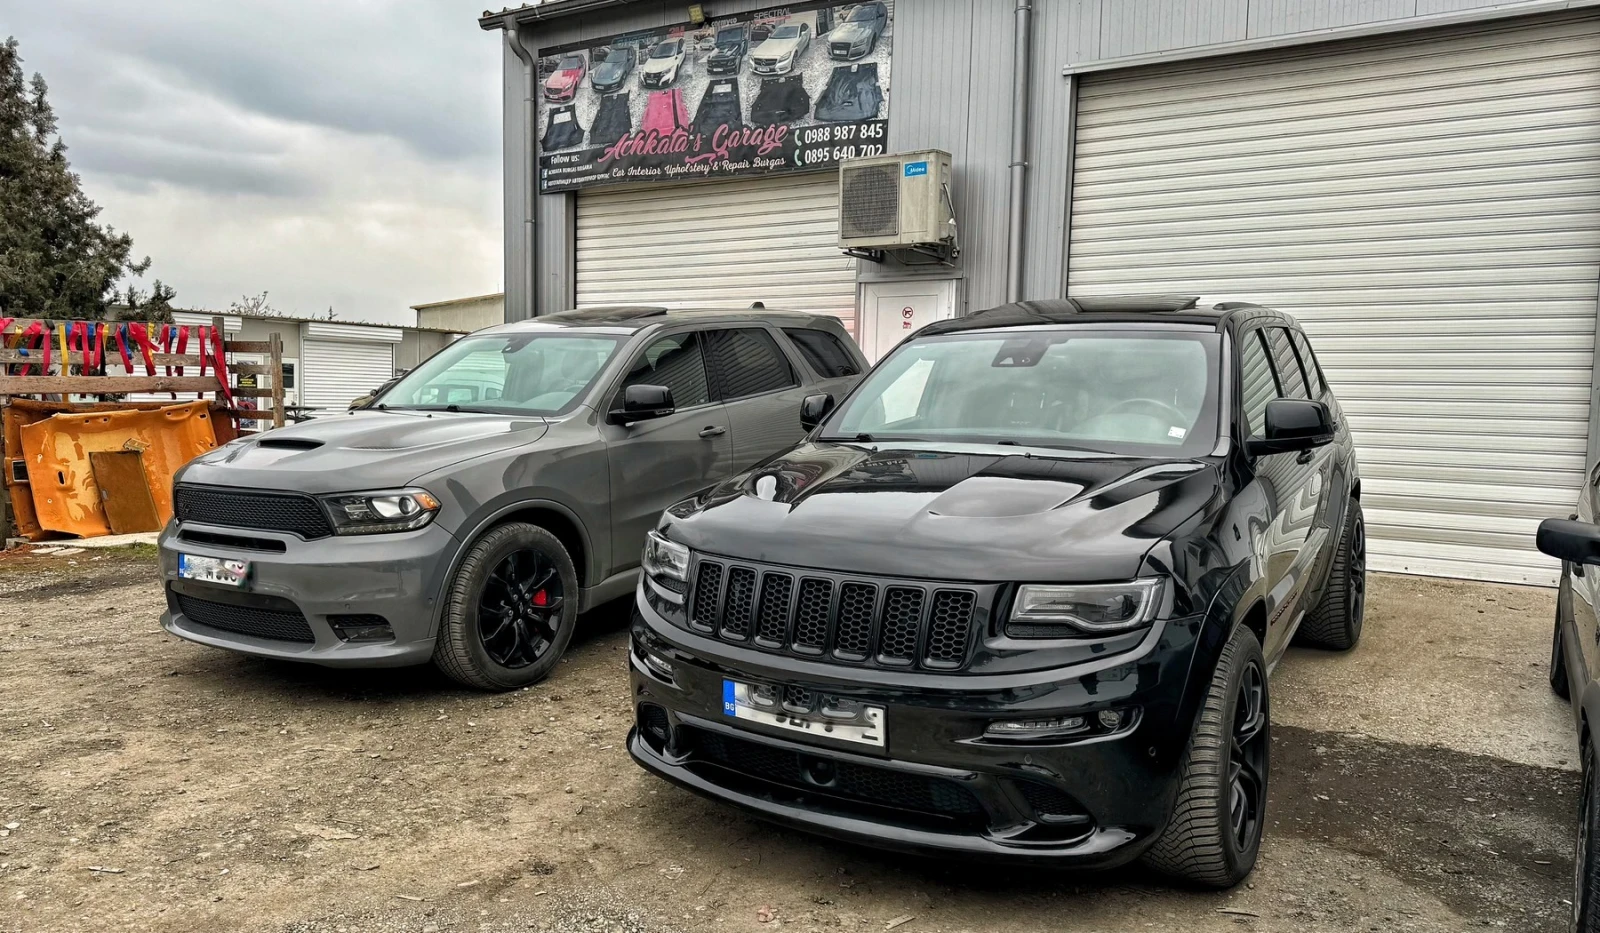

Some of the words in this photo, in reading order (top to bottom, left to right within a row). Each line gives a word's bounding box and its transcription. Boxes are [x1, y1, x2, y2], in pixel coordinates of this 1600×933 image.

[754, 8, 792, 19] SPECTRAL
[805, 127, 830, 143] 0988
[834, 125, 856, 140] 987
[860, 123, 883, 139] 845
[597, 125, 702, 162] Achkata's
[712, 124, 788, 155] Garage
[551, 155, 569, 164] Follow
[805, 148, 829, 164] 0895
[833, 146, 856, 160] 640
[612, 168, 625, 177] Car
[628, 166, 661, 176] Interior
[664, 164, 710, 177] Upholstery
[712, 162, 719, 171] &
[722, 160, 750, 172] Repair
[753, 157, 786, 170] Burgas
[725, 701, 735, 711] BG
